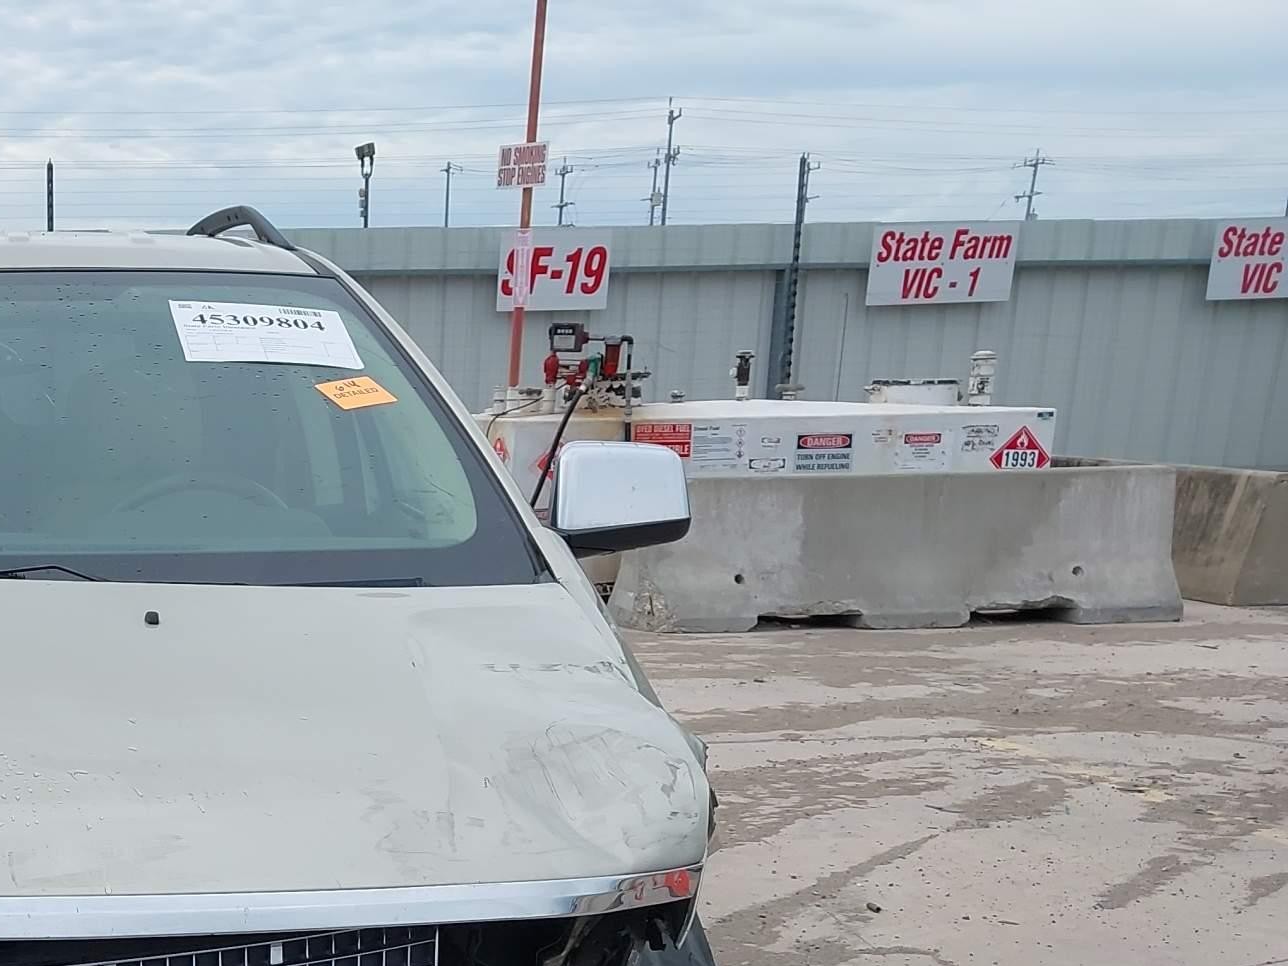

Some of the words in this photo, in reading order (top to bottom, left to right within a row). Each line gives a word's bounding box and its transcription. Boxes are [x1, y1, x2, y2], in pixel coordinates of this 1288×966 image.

[501, 148, 512, 166] NO
[498, 168, 515, 186] STOP
[877, 231, 944, 262] State
[949, 229, 1012, 259] Farm
[1218, 226, 1285, 258] State
[901, 267, 943, 299] VIC
[967, 267, 981, 297] 1
[1240, 262, 1283, 294] VIC
[192, 313, 326, 332] 45309804
[333, 387, 379, 399] DETAILED
[807, 437, 843, 447] DANGER
[1004, 451, 1036, 467] 1993
